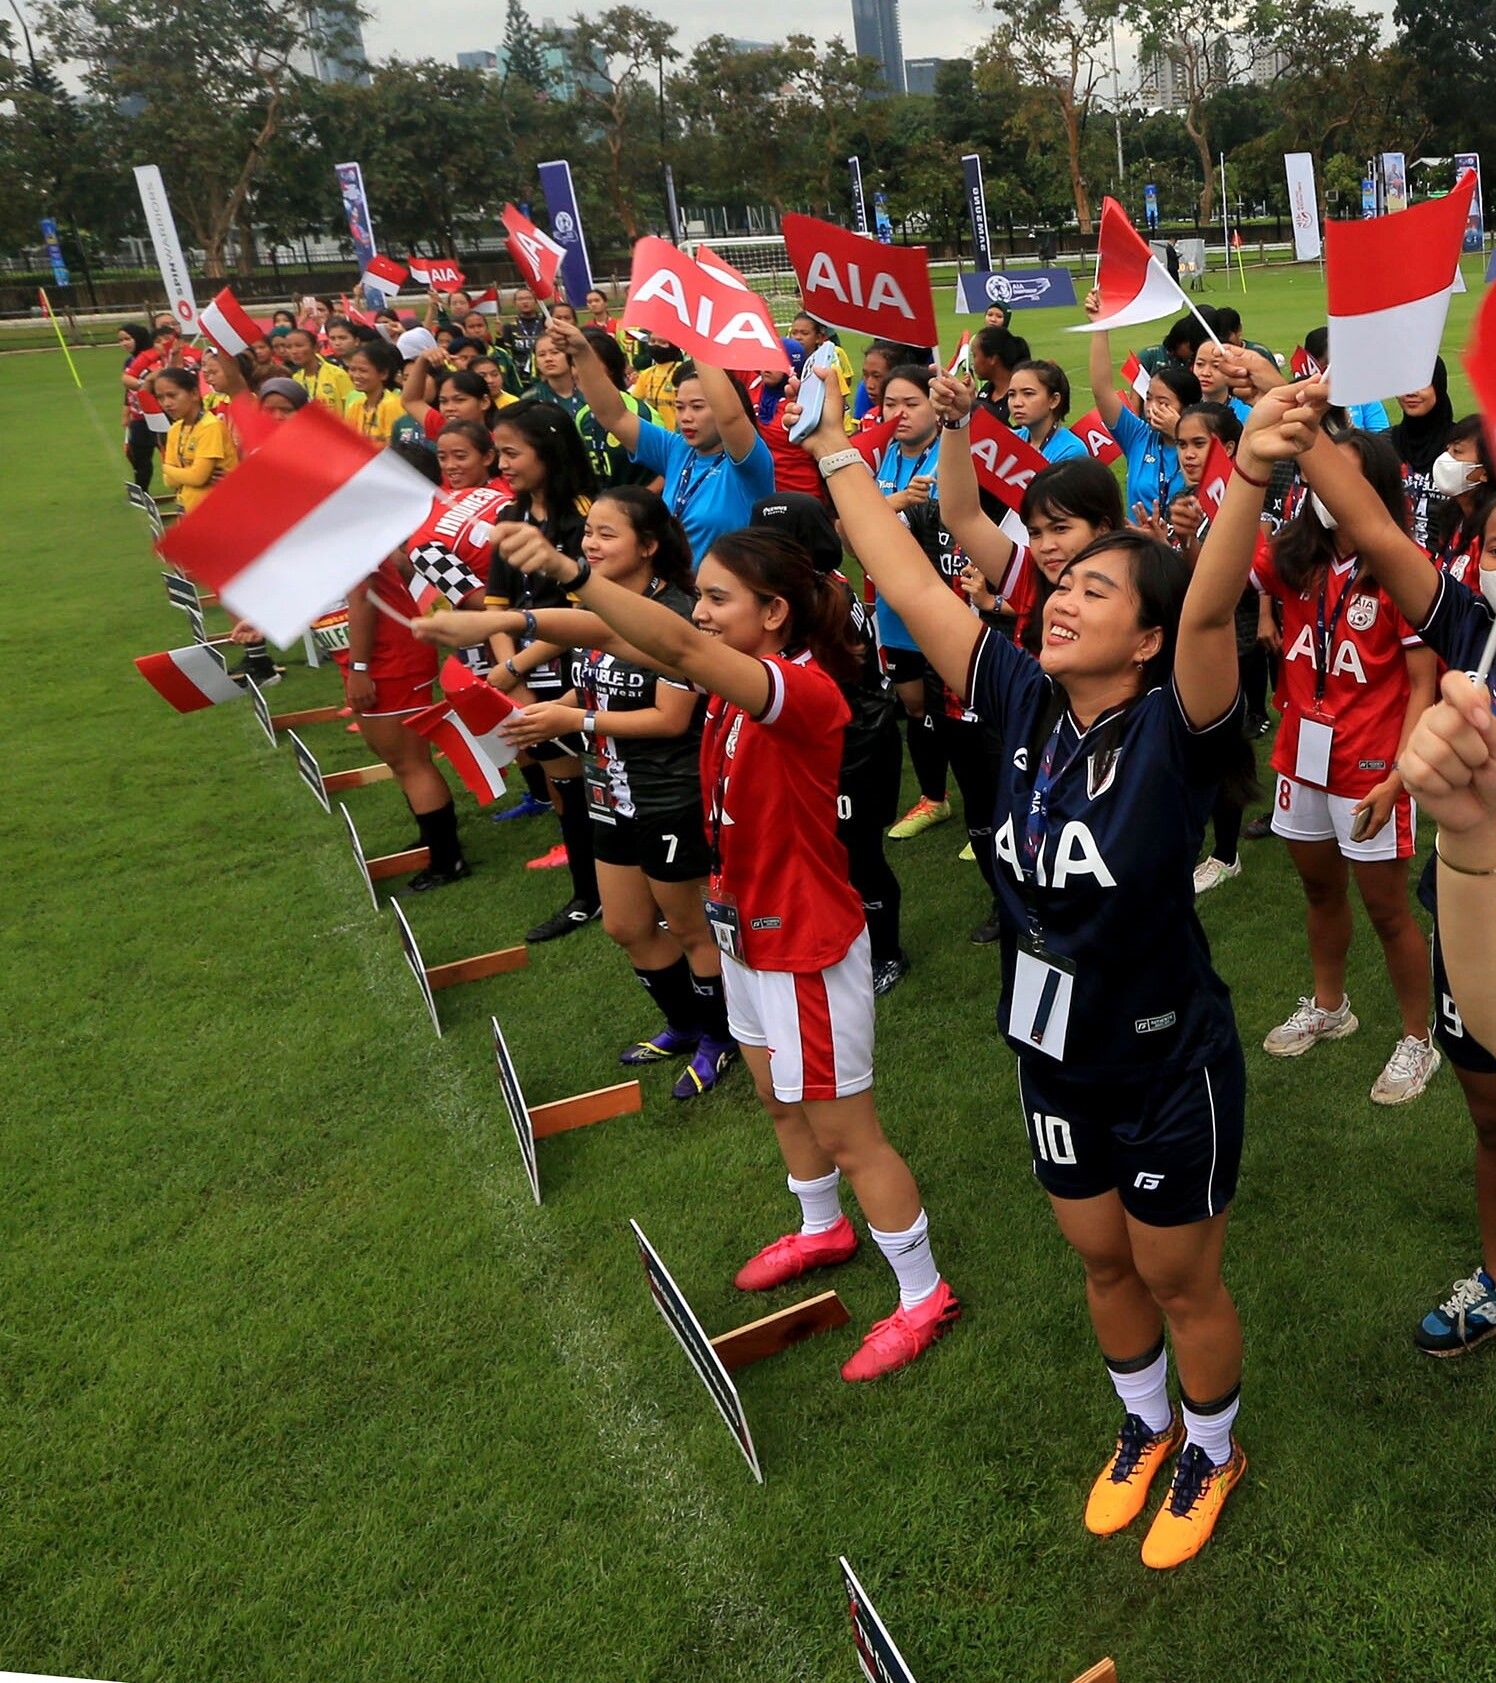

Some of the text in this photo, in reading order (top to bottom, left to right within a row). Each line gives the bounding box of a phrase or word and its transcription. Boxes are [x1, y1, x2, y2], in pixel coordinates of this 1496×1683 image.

[431, 267, 459, 282] AIA
[806, 252, 916, 320] AIA
[633, 268, 779, 350] AIA
[1355, 597, 1374, 610] AIA
[1285, 624, 1368, 684] AIA
[1030, 790, 1041, 814] AIA
[1279, 779, 1291, 810] 8
[661, 834, 679, 864] 7
[995, 812, 1118, 888] AIA
[1032, 1112, 1077, 1165] 10
